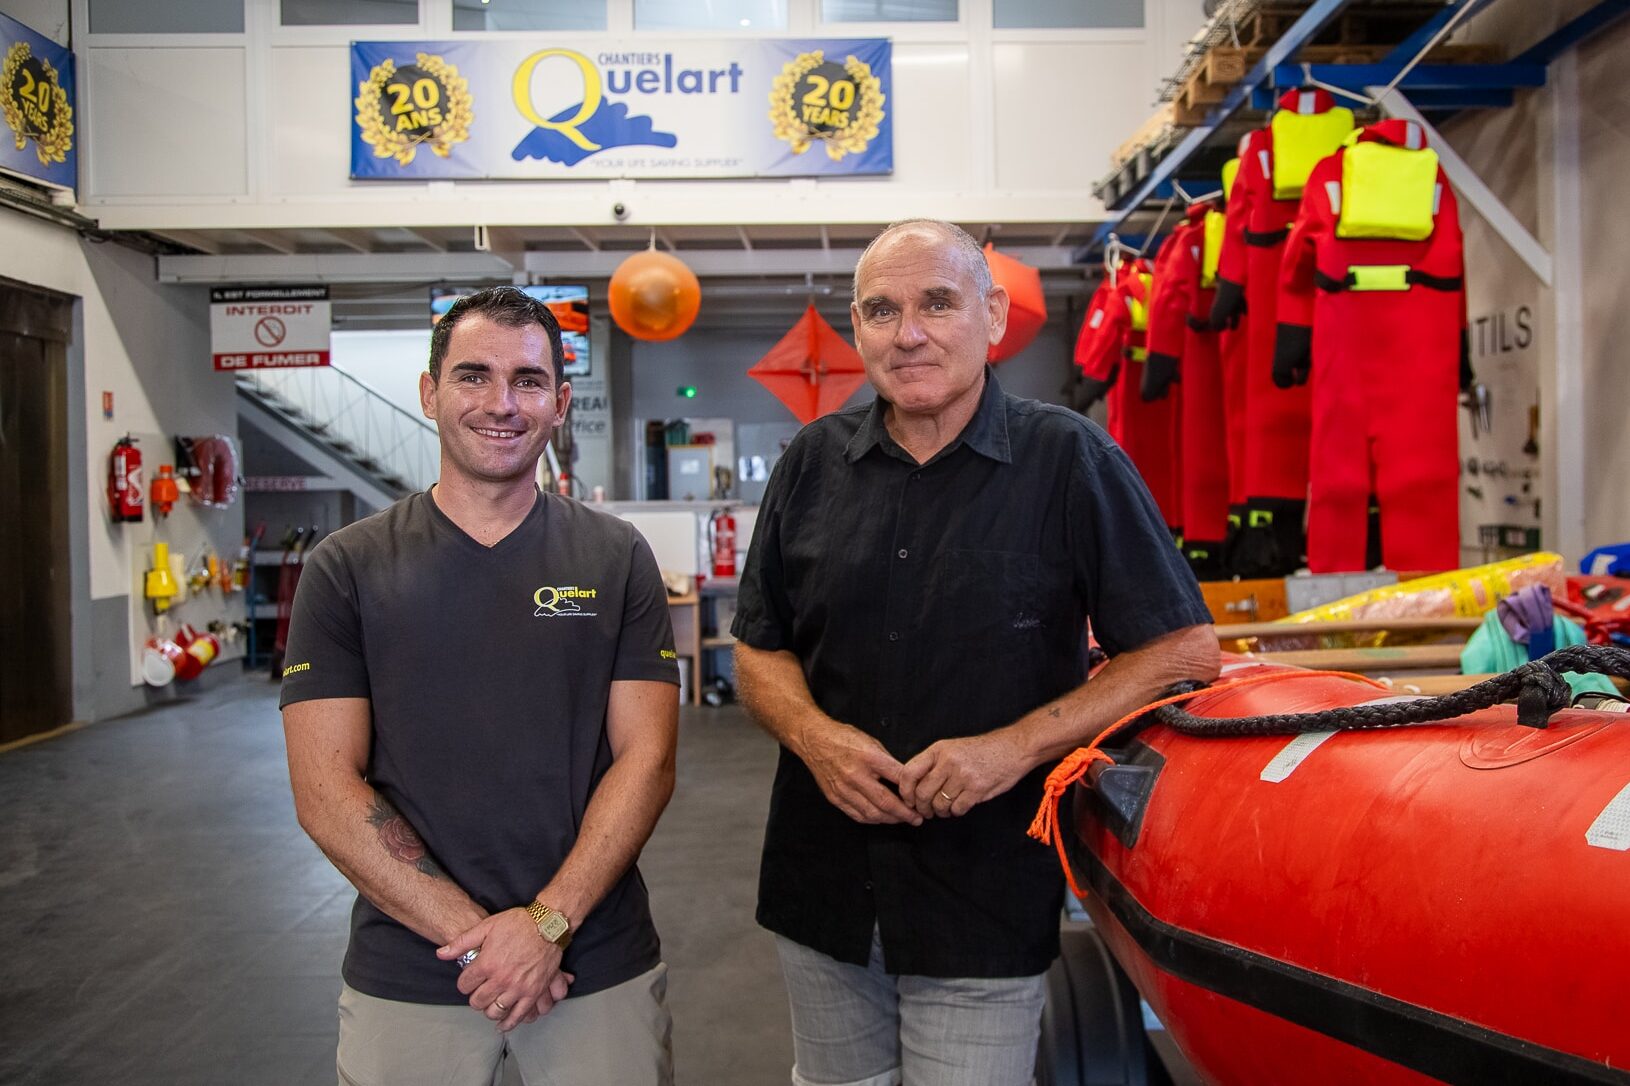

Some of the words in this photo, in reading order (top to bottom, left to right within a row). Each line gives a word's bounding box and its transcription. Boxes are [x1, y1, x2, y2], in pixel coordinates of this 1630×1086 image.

[598, 53, 661, 66] CHANTIERS
[19, 69, 50, 112] 20
[386, 78, 440, 115] 20
[511, 47, 743, 151] Quelart
[802, 74, 855, 110] 20
[21, 98, 48, 132] YEARS
[395, 107, 443, 132] ANS
[802, 105, 849, 128] YEARS
[225, 304, 313, 316] INTERDIT
[1470, 306, 1532, 357] TILS
[220, 355, 247, 368] DE
[252, 353, 320, 367] FUMER
[534, 586, 597, 612] Quelart
